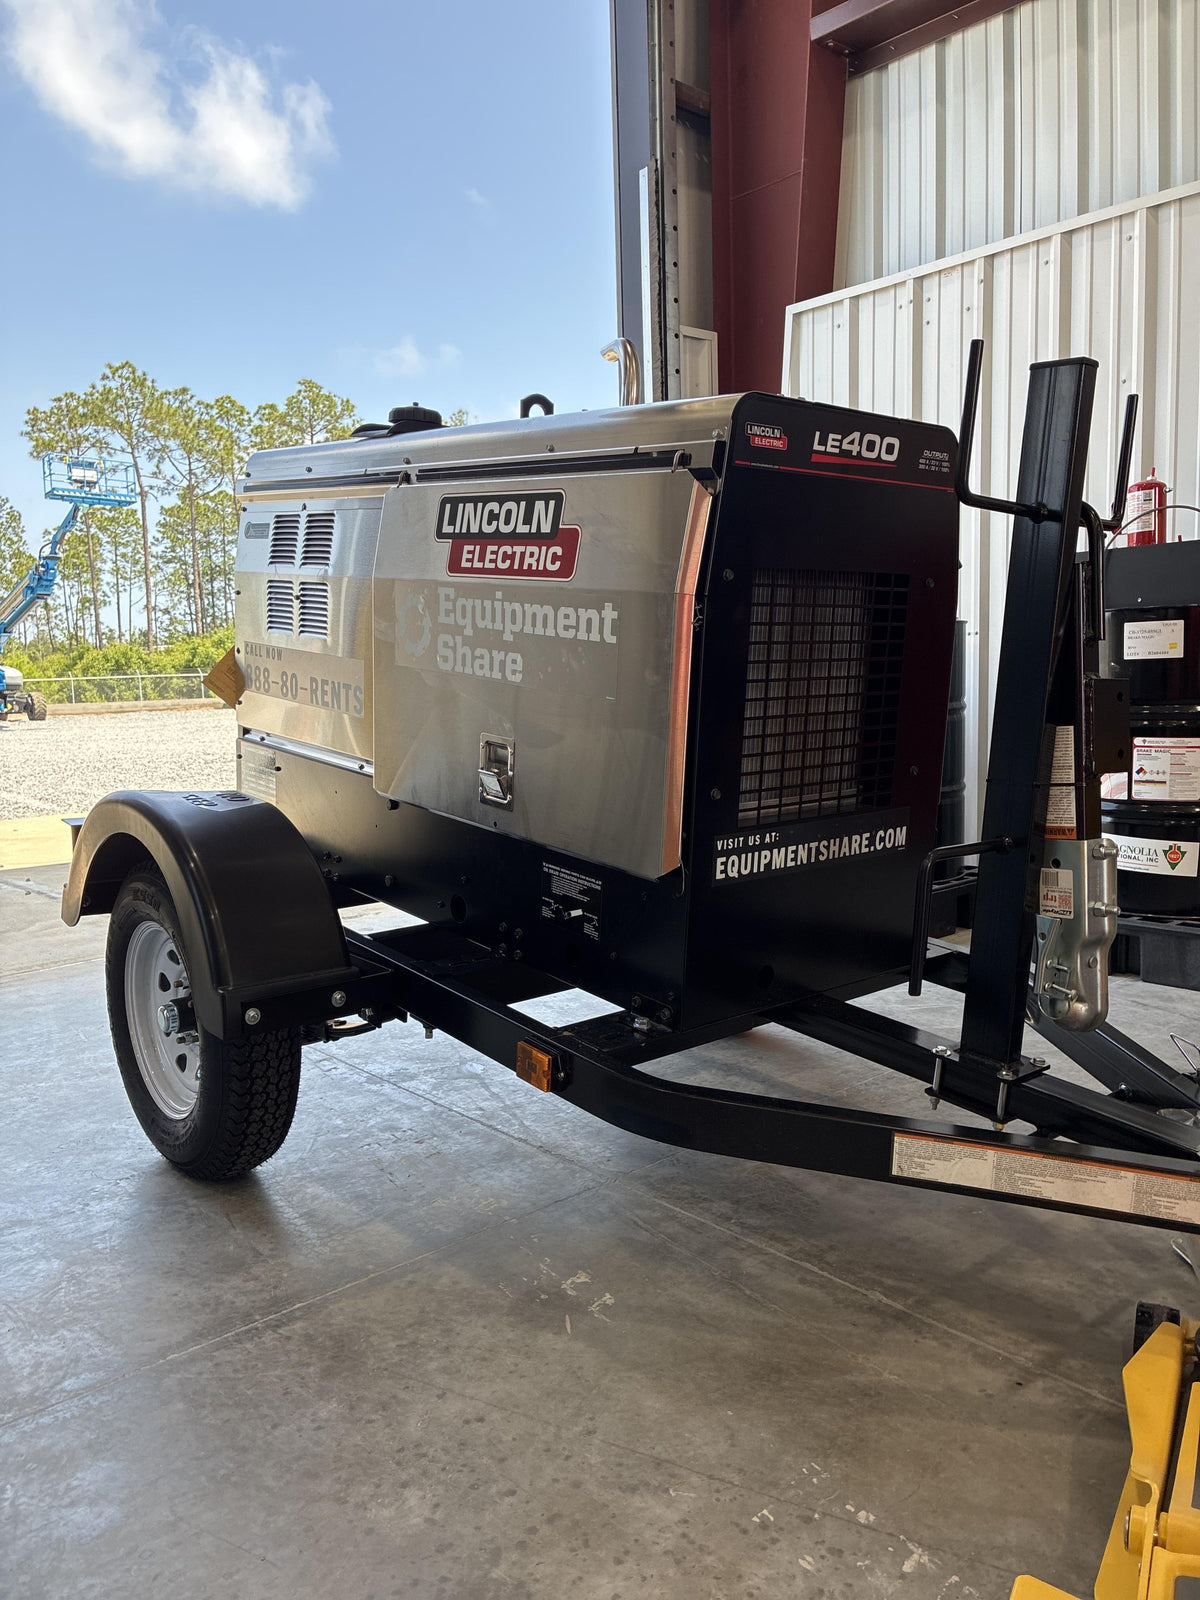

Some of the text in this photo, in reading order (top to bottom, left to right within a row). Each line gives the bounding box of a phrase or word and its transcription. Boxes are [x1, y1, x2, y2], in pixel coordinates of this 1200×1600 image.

[747, 424, 781, 438] LINCOLN
[754, 437, 784, 448] ELECTRIC
[813, 430, 900, 462] LE400
[441, 500, 556, 533] LINCOLN
[460, 545, 563, 571] ELECTRIC
[437, 586, 618, 644] Equipment
[245, 643, 283, 661] CALL NOW
[437, 633, 524, 683] Share
[715, 825, 907, 880] EQUIPMENTSHARE.COM
[717, 832, 780, 851] VISIT US AT:
